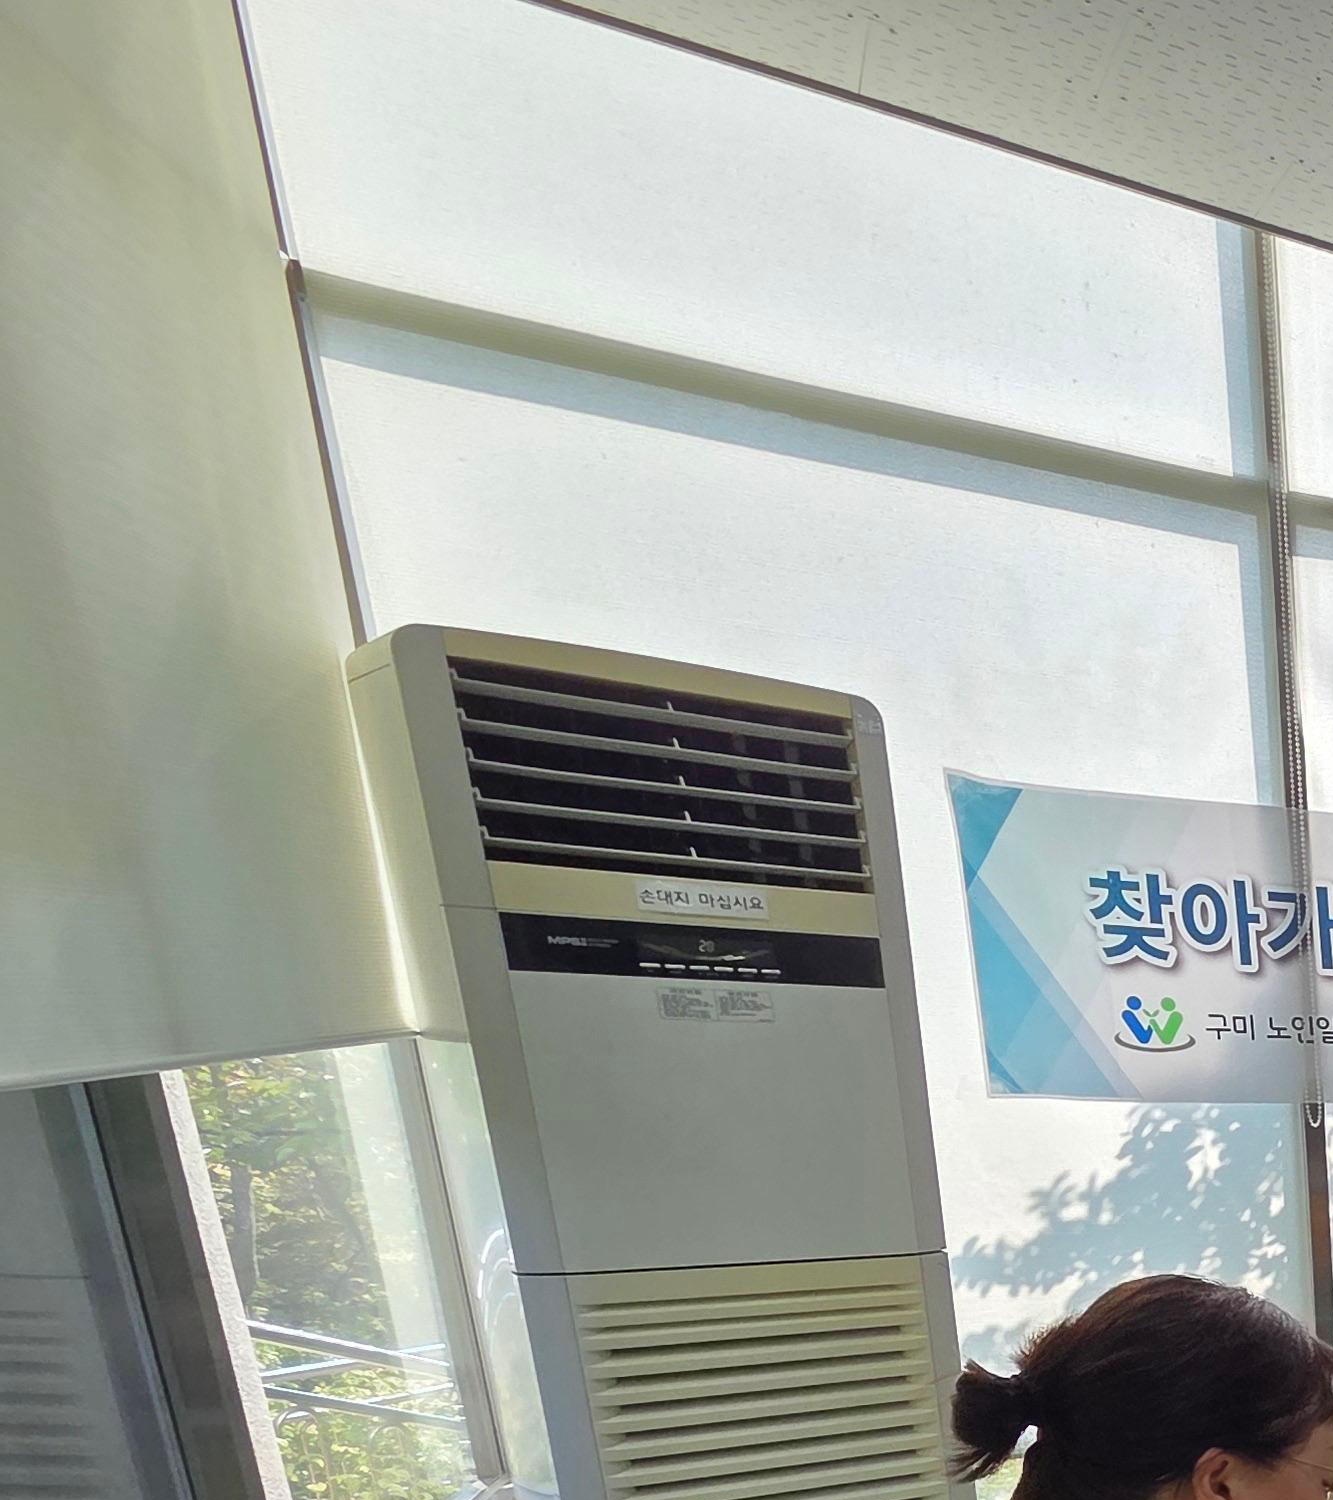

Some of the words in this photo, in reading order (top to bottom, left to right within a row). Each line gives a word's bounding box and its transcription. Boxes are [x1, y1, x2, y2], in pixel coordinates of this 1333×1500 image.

[639, 888, 690, 905] 손대지
[699, 893, 764, 911] 마십시요
[1205, 1013, 1256, 1041] 구미
